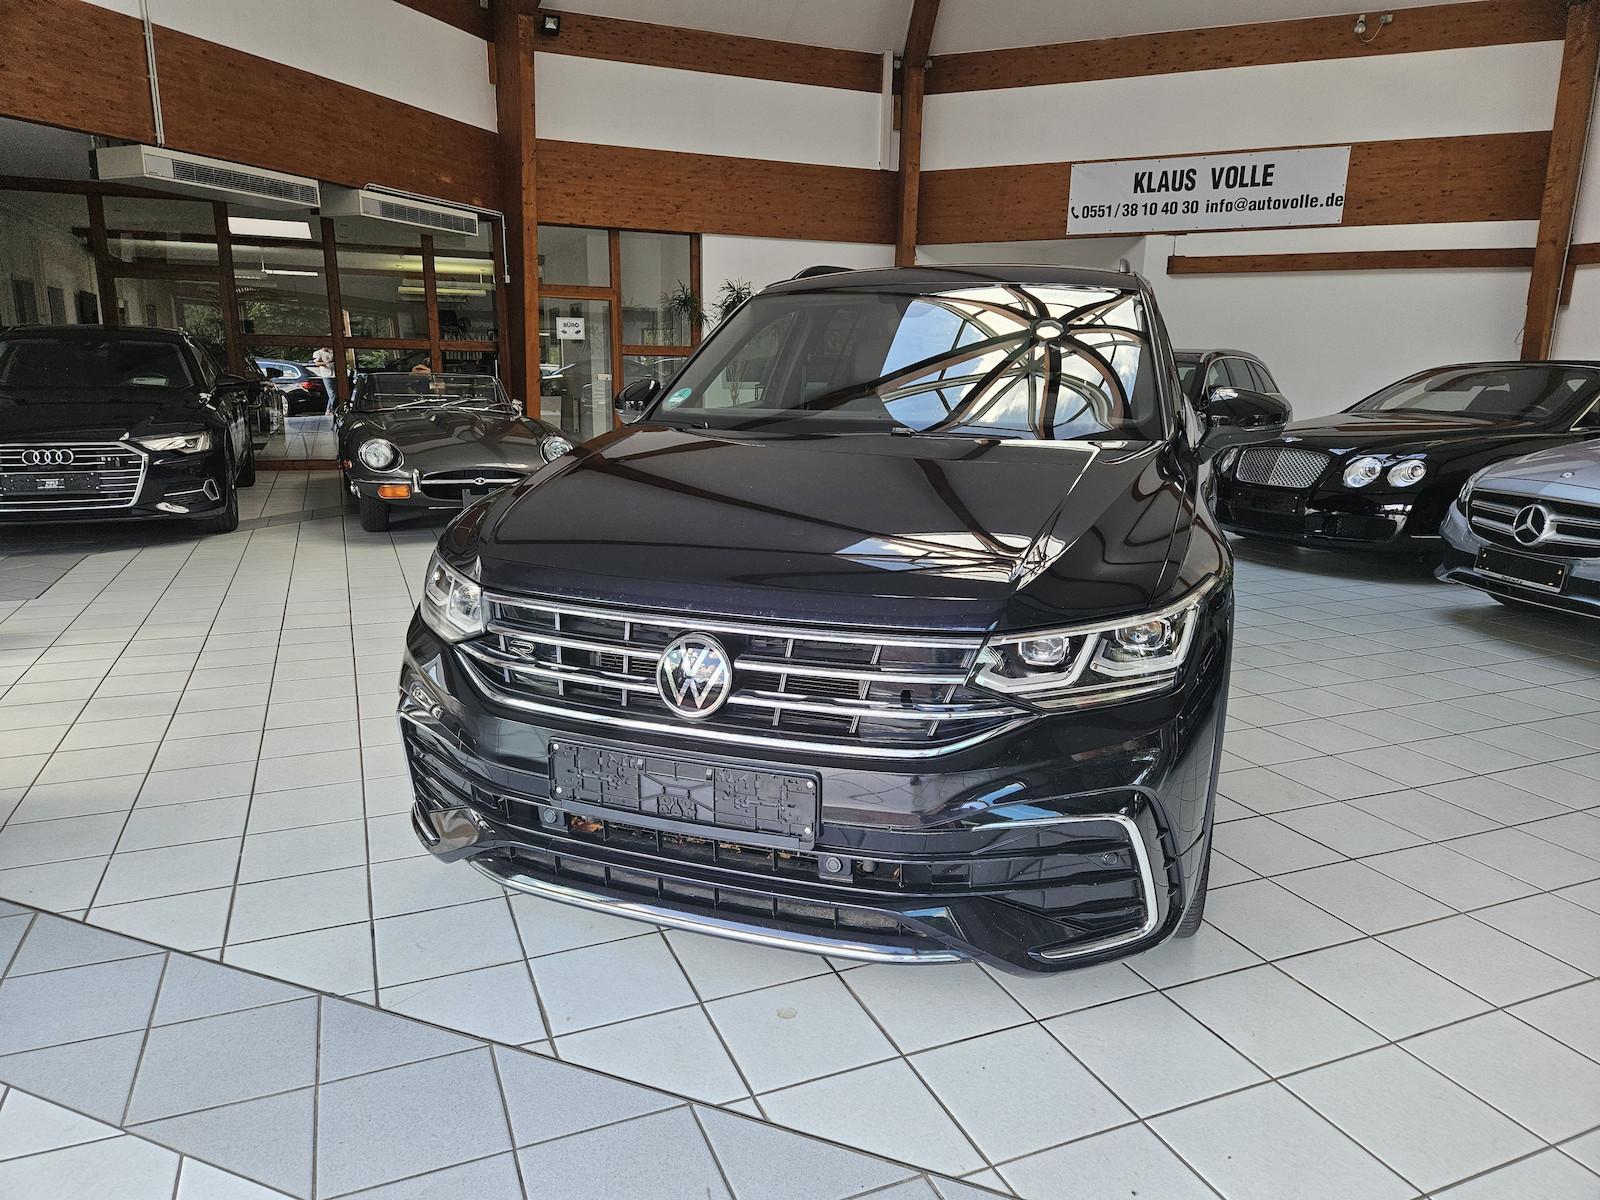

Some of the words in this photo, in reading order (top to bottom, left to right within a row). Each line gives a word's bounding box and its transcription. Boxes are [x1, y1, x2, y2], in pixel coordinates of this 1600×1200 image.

[1133, 168, 1197, 194] KLAUS
[1211, 164, 1275, 190] VOLLE
[1142, 202, 1158, 216] 10
[1161, 201, 1178, 215] 40
[1182, 200, 1199, 214] 30
[1205, 192, 1344, 213] info@autovolle.de
